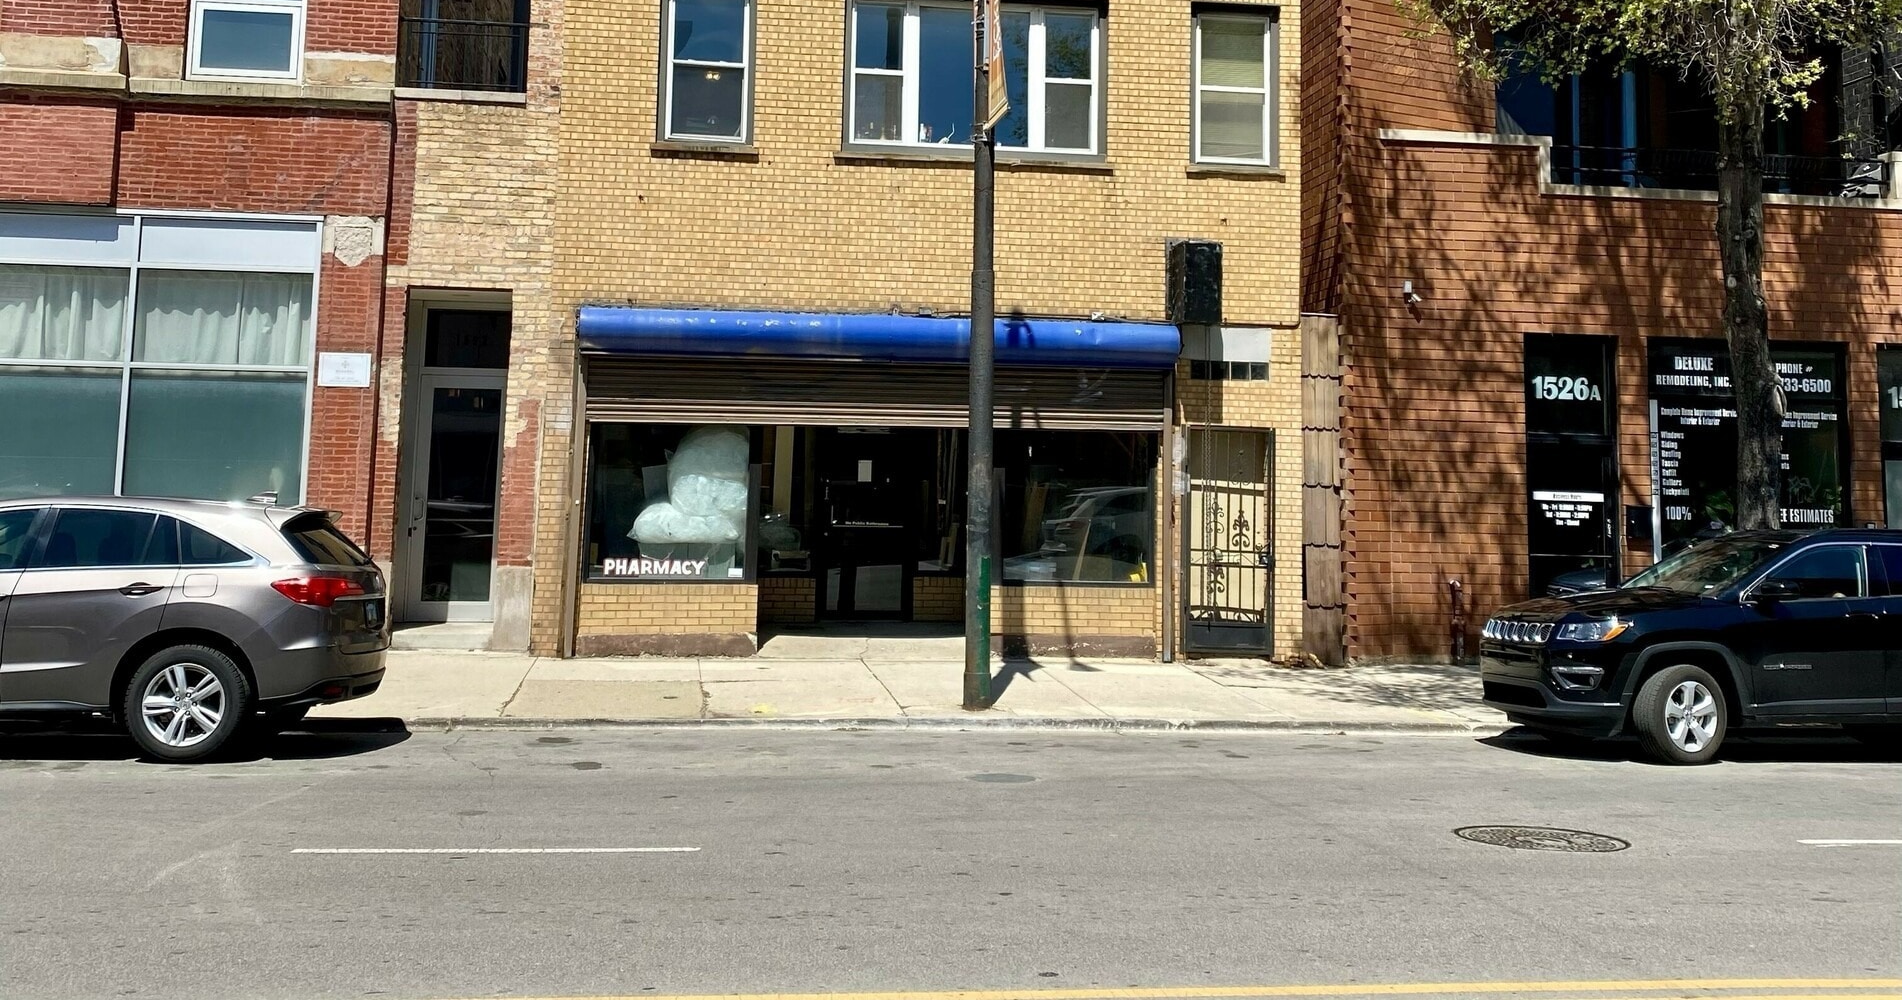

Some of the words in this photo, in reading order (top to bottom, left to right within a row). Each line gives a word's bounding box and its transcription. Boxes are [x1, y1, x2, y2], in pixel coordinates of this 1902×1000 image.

[1674, 356, 1714, 371] DELUXE
[1775, 363, 1803, 374] PHONE
[1532, 375, 1602, 402] 1526A
[1656, 374, 1712, 388] REMODELING,
[1714, 376, 1732, 388] INC.
[1887, 386, 1902, 409] 1
[1660, 431, 1685, 440] Windows
[1665, 505, 1692, 521] 100%
[1789, 508, 1834, 524] ESTIMATES
[603, 558, 706, 576] PHARMACY
